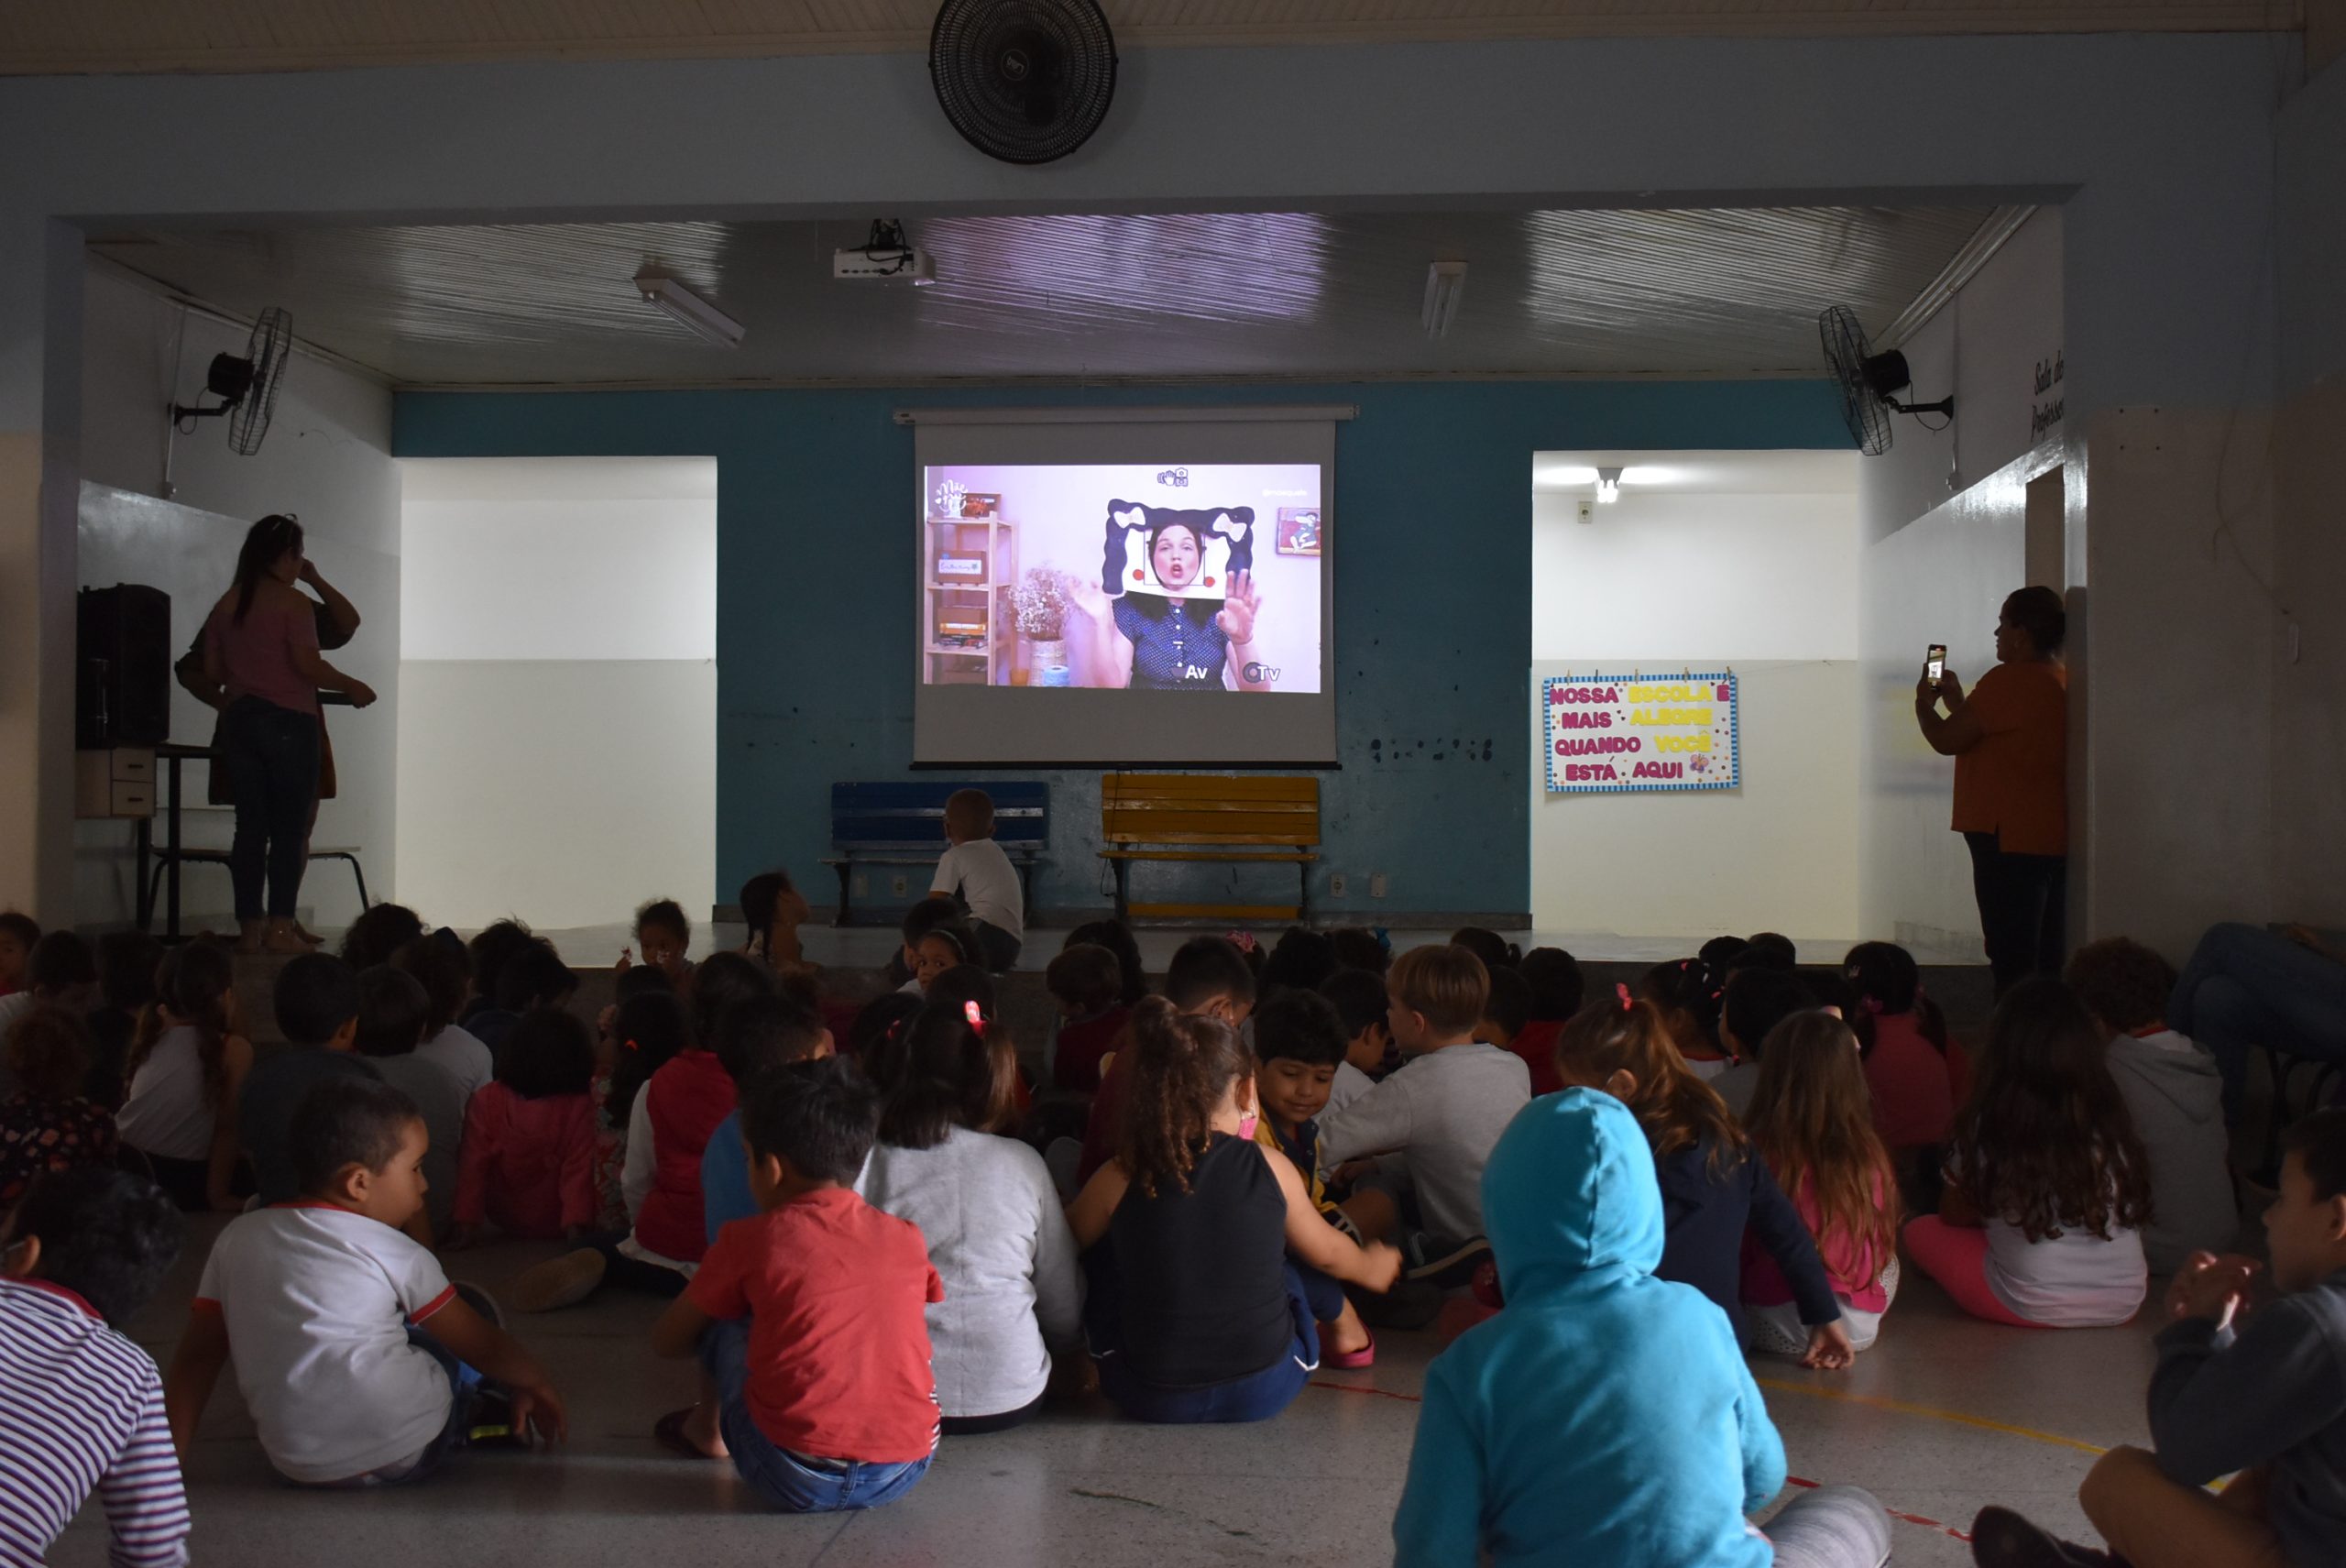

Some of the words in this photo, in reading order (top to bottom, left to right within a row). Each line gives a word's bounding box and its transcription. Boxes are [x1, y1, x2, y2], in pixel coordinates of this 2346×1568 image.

[2034, 358, 2052, 396] Sala
[1549, 686, 1619, 705] NOSSA
[1628, 685, 1712, 704] ESCOLA
[1716, 679, 1730, 702] É
[1561, 711, 1612, 729] MAIS
[1629, 708, 1714, 726] ALEGRE
[1554, 736, 1641, 756] QUANDO
[1653, 730, 1713, 753] VOCÊ
[1565, 756, 1617, 781] ESTÁ
[1632, 762, 1683, 780] AQUI
